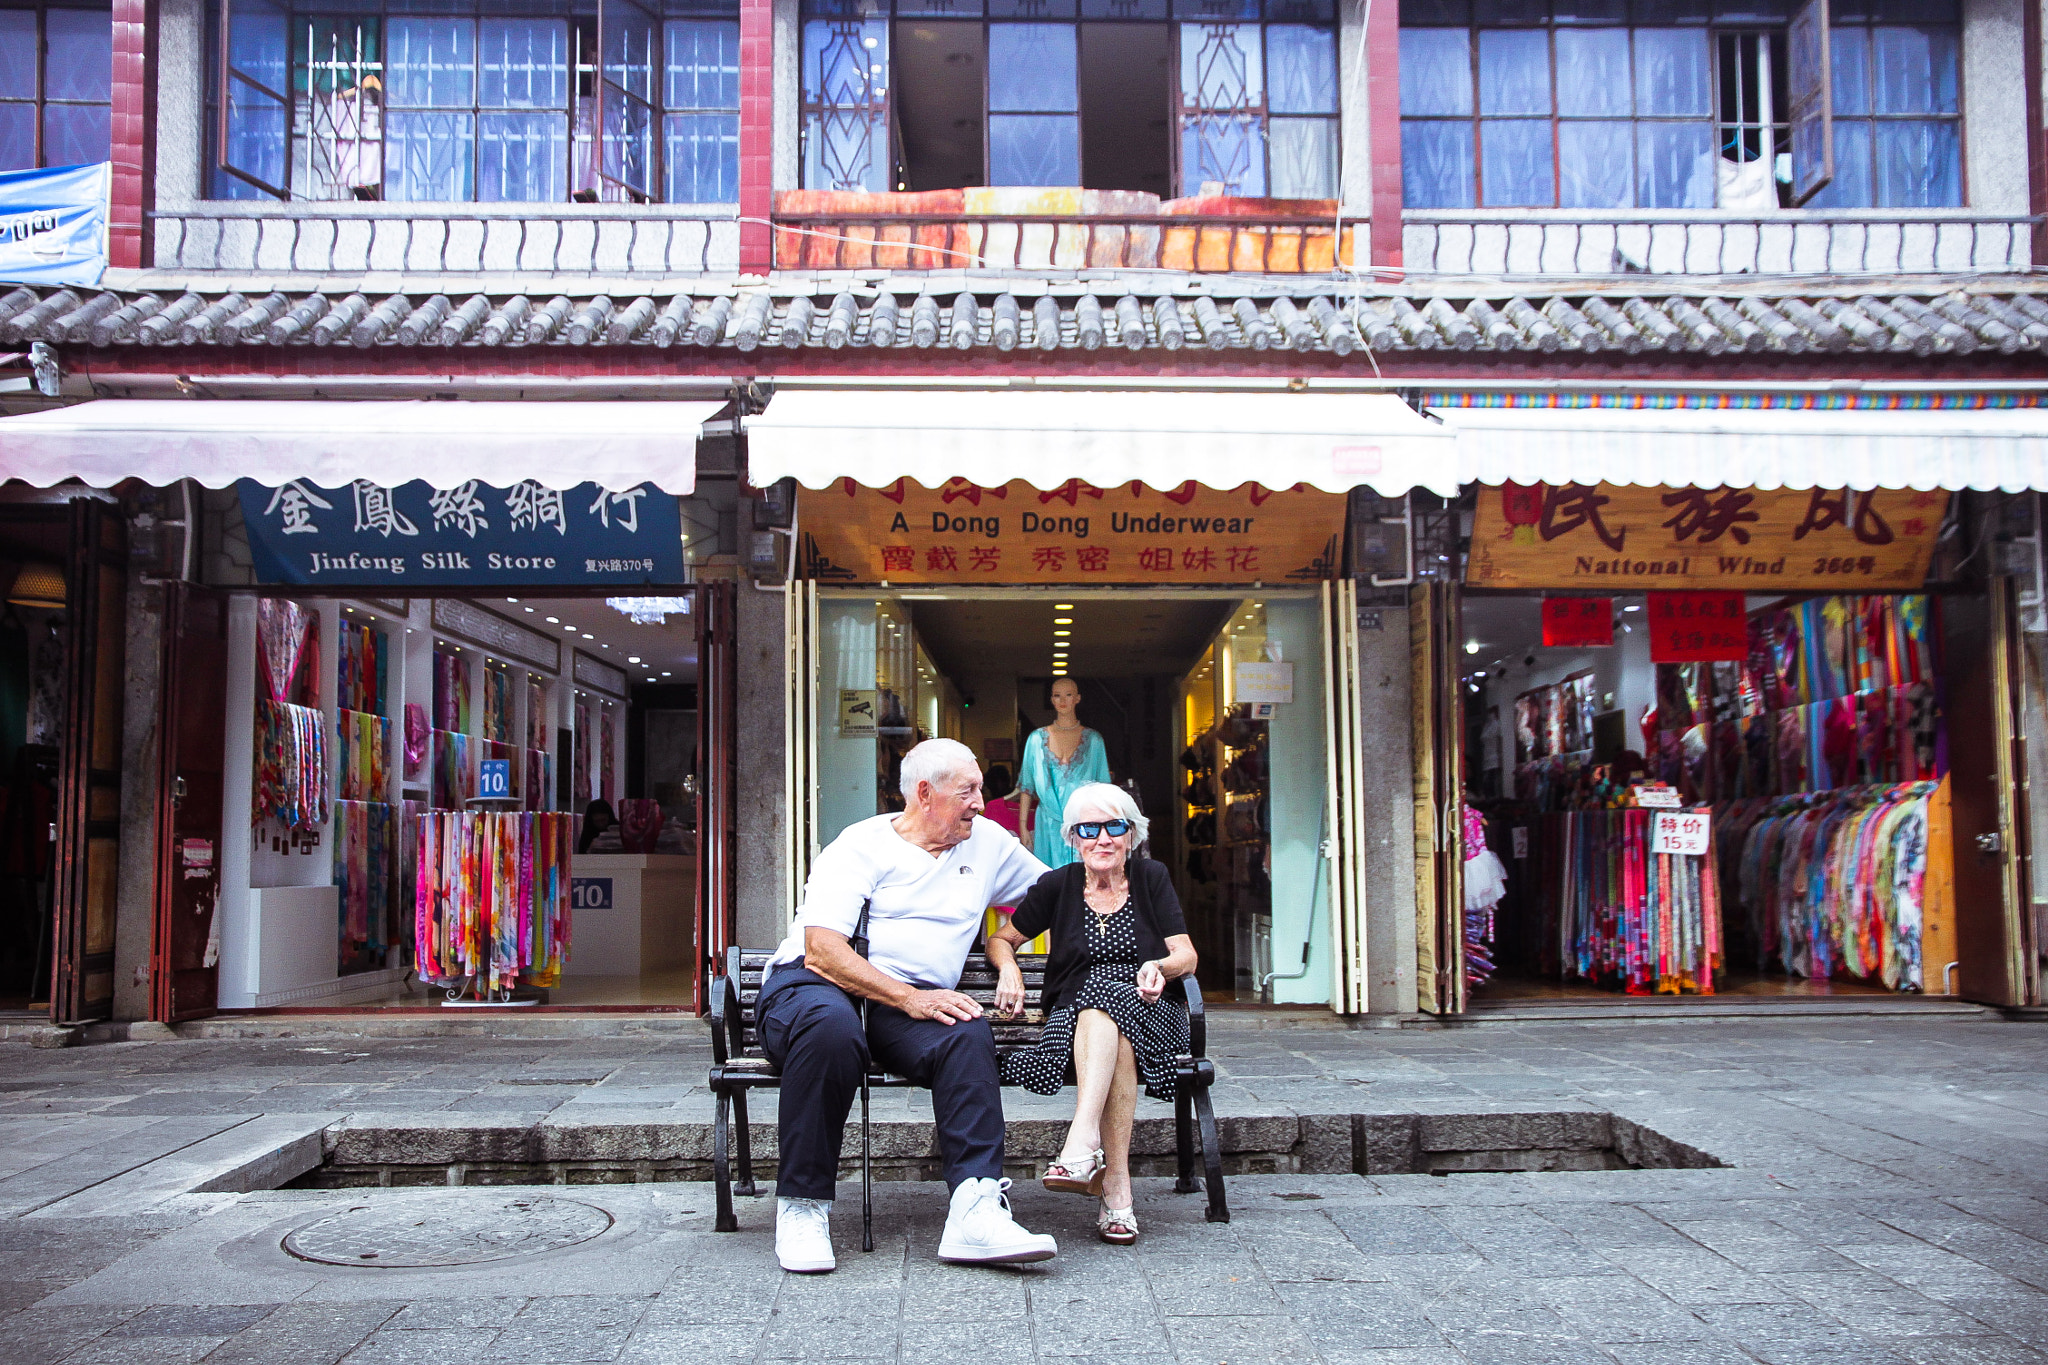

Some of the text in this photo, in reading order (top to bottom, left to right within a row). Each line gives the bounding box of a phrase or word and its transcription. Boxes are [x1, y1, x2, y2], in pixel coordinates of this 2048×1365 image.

[890, 511, 1255, 538] A Dong Dong Underwear
[310, 552, 557, 574] Jinfeng Silk Store
[584, 558, 655, 573] 复兴路370号
[1660, 817, 1703, 833] 特价
